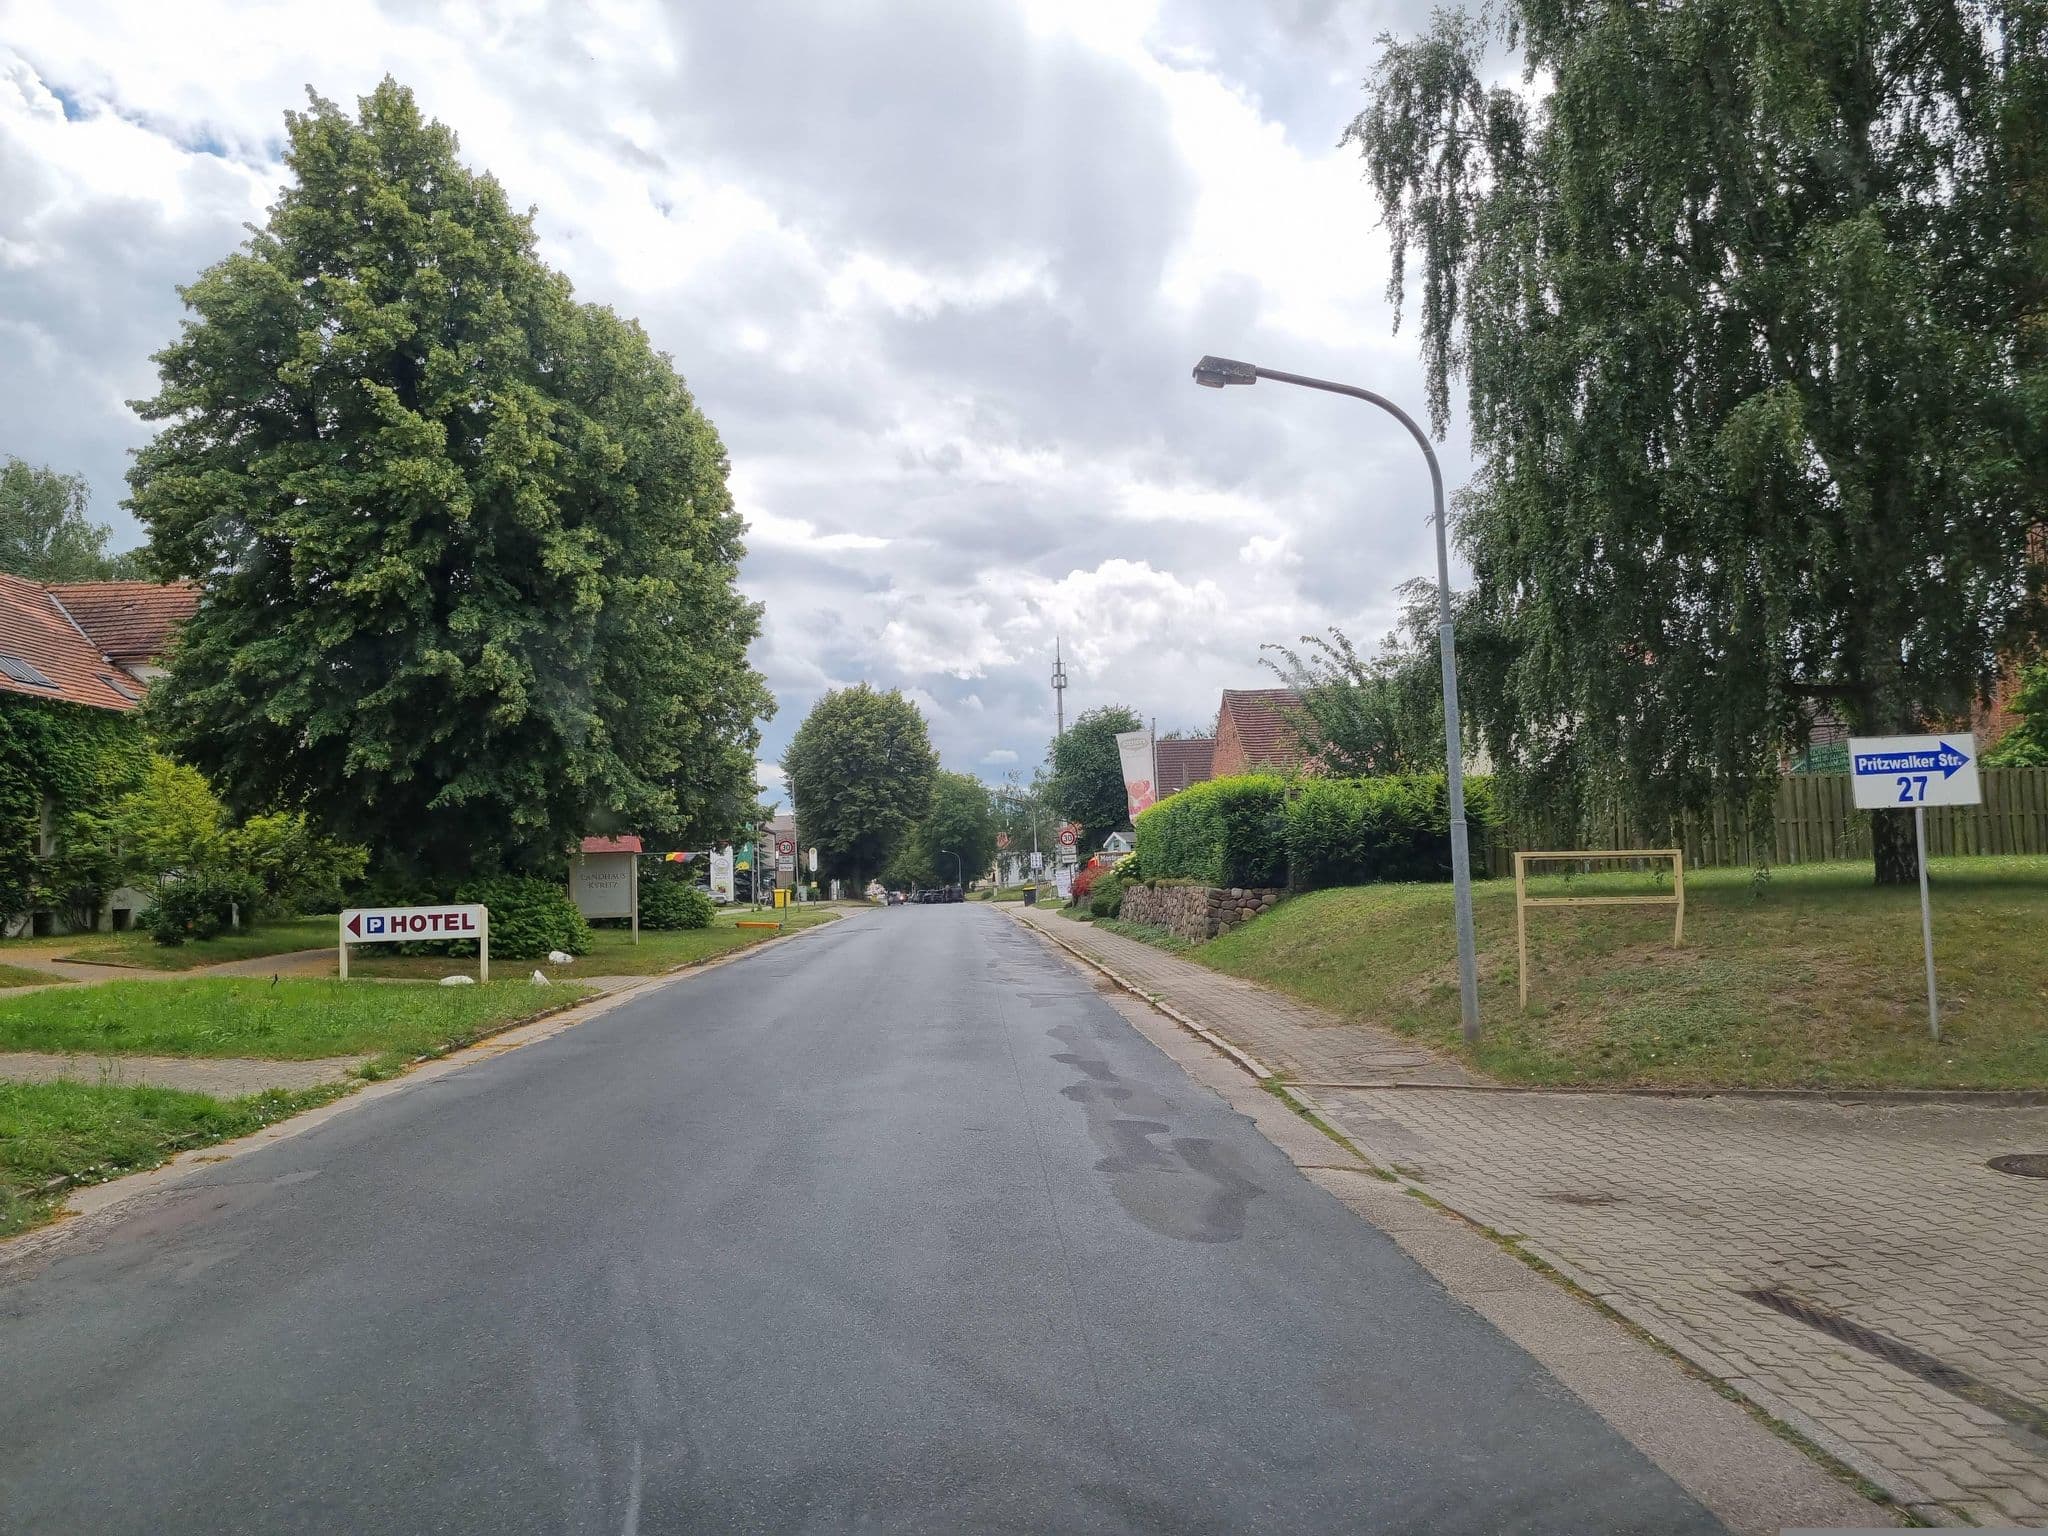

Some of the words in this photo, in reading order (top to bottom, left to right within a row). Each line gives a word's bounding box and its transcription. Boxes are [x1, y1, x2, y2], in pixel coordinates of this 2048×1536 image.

[1858, 755, 1935, 771] Pritzwalker
[1938, 753, 1962, 767] Str.
[1896, 775, 1928, 802] 27
[781, 843, 791, 851] 30
[1063, 834, 1072, 842] 30
[369, 919, 382, 931] P
[390, 913, 475, 933] HOTEL
